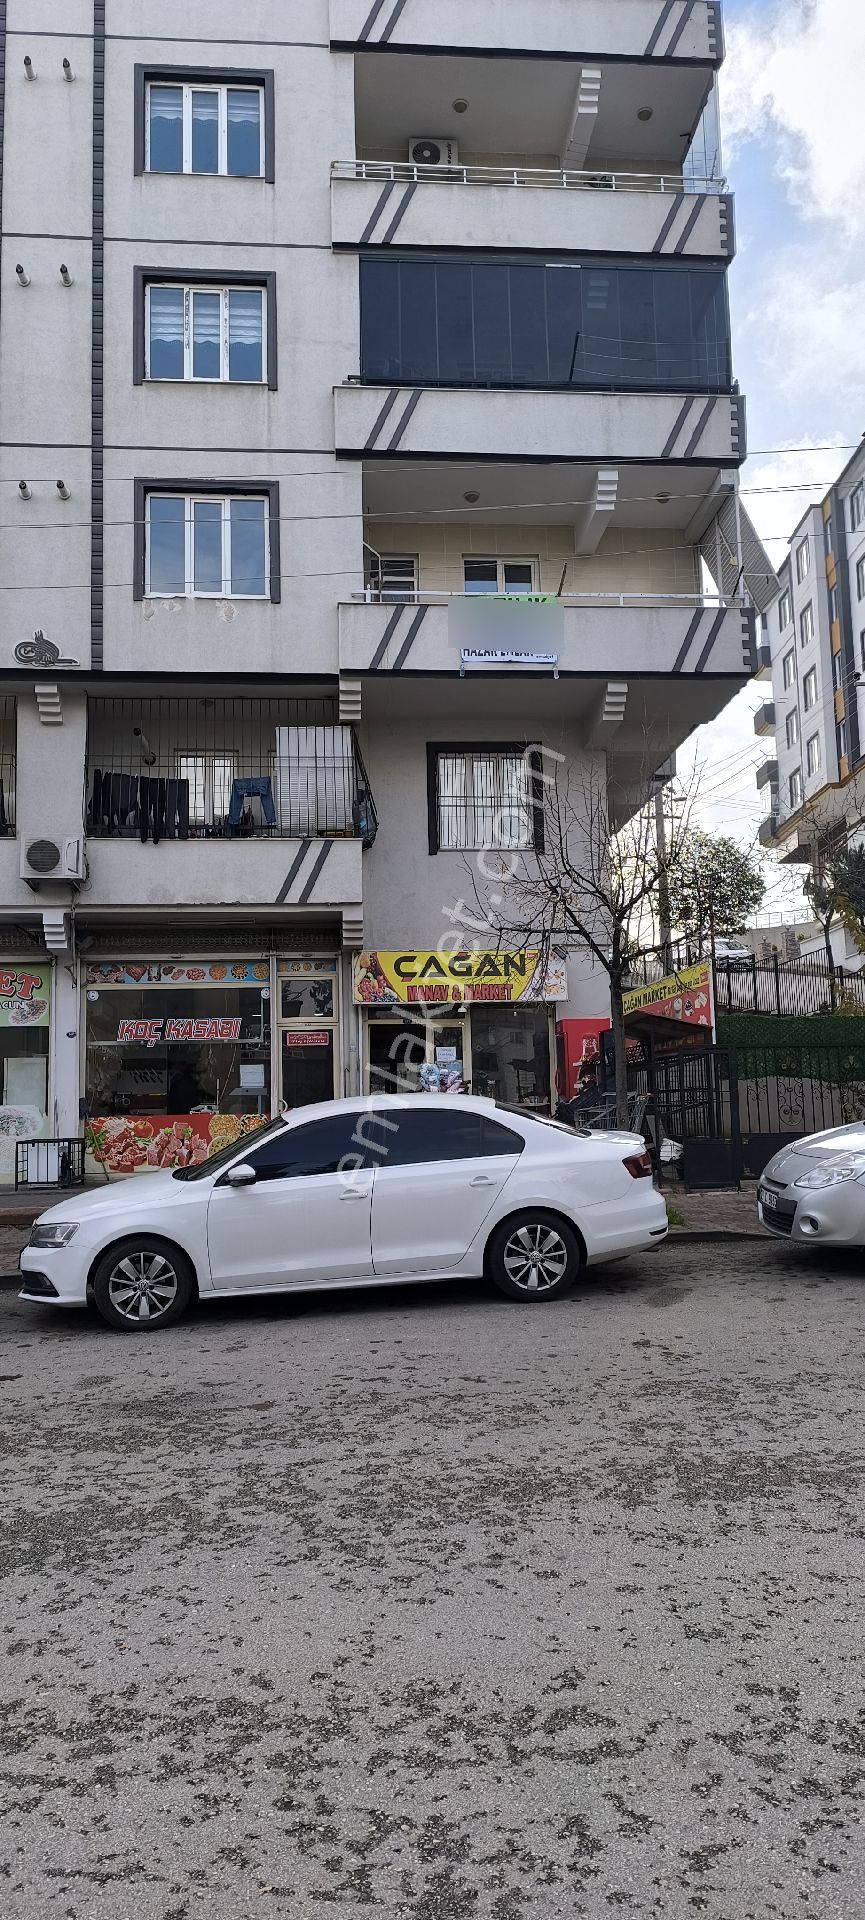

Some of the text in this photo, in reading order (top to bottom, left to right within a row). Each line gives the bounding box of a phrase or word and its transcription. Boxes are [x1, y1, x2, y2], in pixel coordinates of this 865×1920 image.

[394, 952, 526, 982] ÇAĞAN
[407, 984, 513, 1001] MANAV & MARKET
[642, 986, 667, 1007] MARKET
[117, 1018, 242, 1047] KOÇ KASABI
